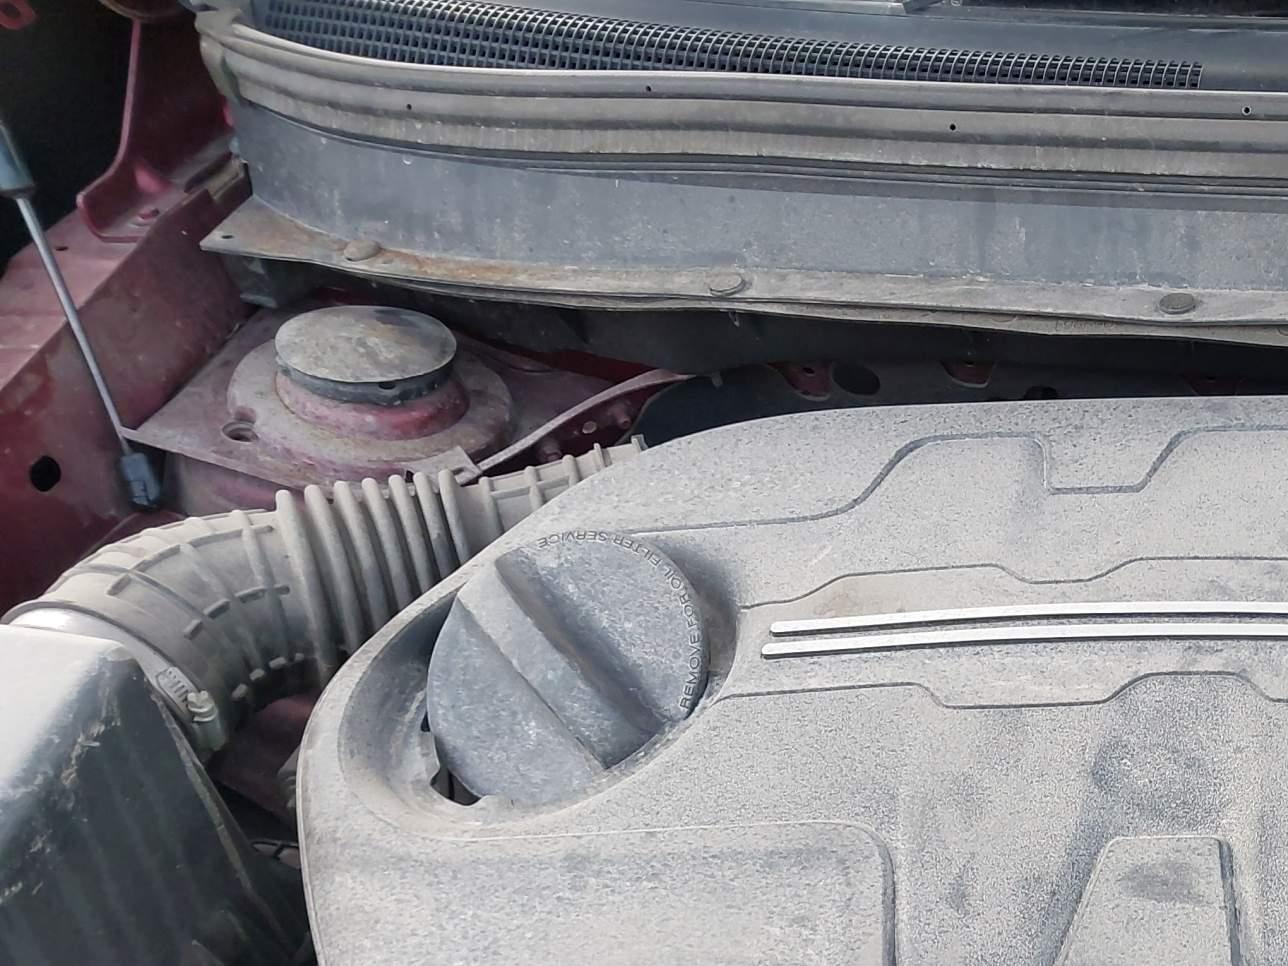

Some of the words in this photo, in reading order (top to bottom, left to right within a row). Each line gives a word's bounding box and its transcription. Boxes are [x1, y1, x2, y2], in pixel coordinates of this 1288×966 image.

[537, 530, 608, 549] SERVICE
[613, 534, 663, 567] FILTER
[664, 570, 682, 590] OIL
[680, 588, 699, 628] FOR
[680, 627, 702, 710] REMOVE
